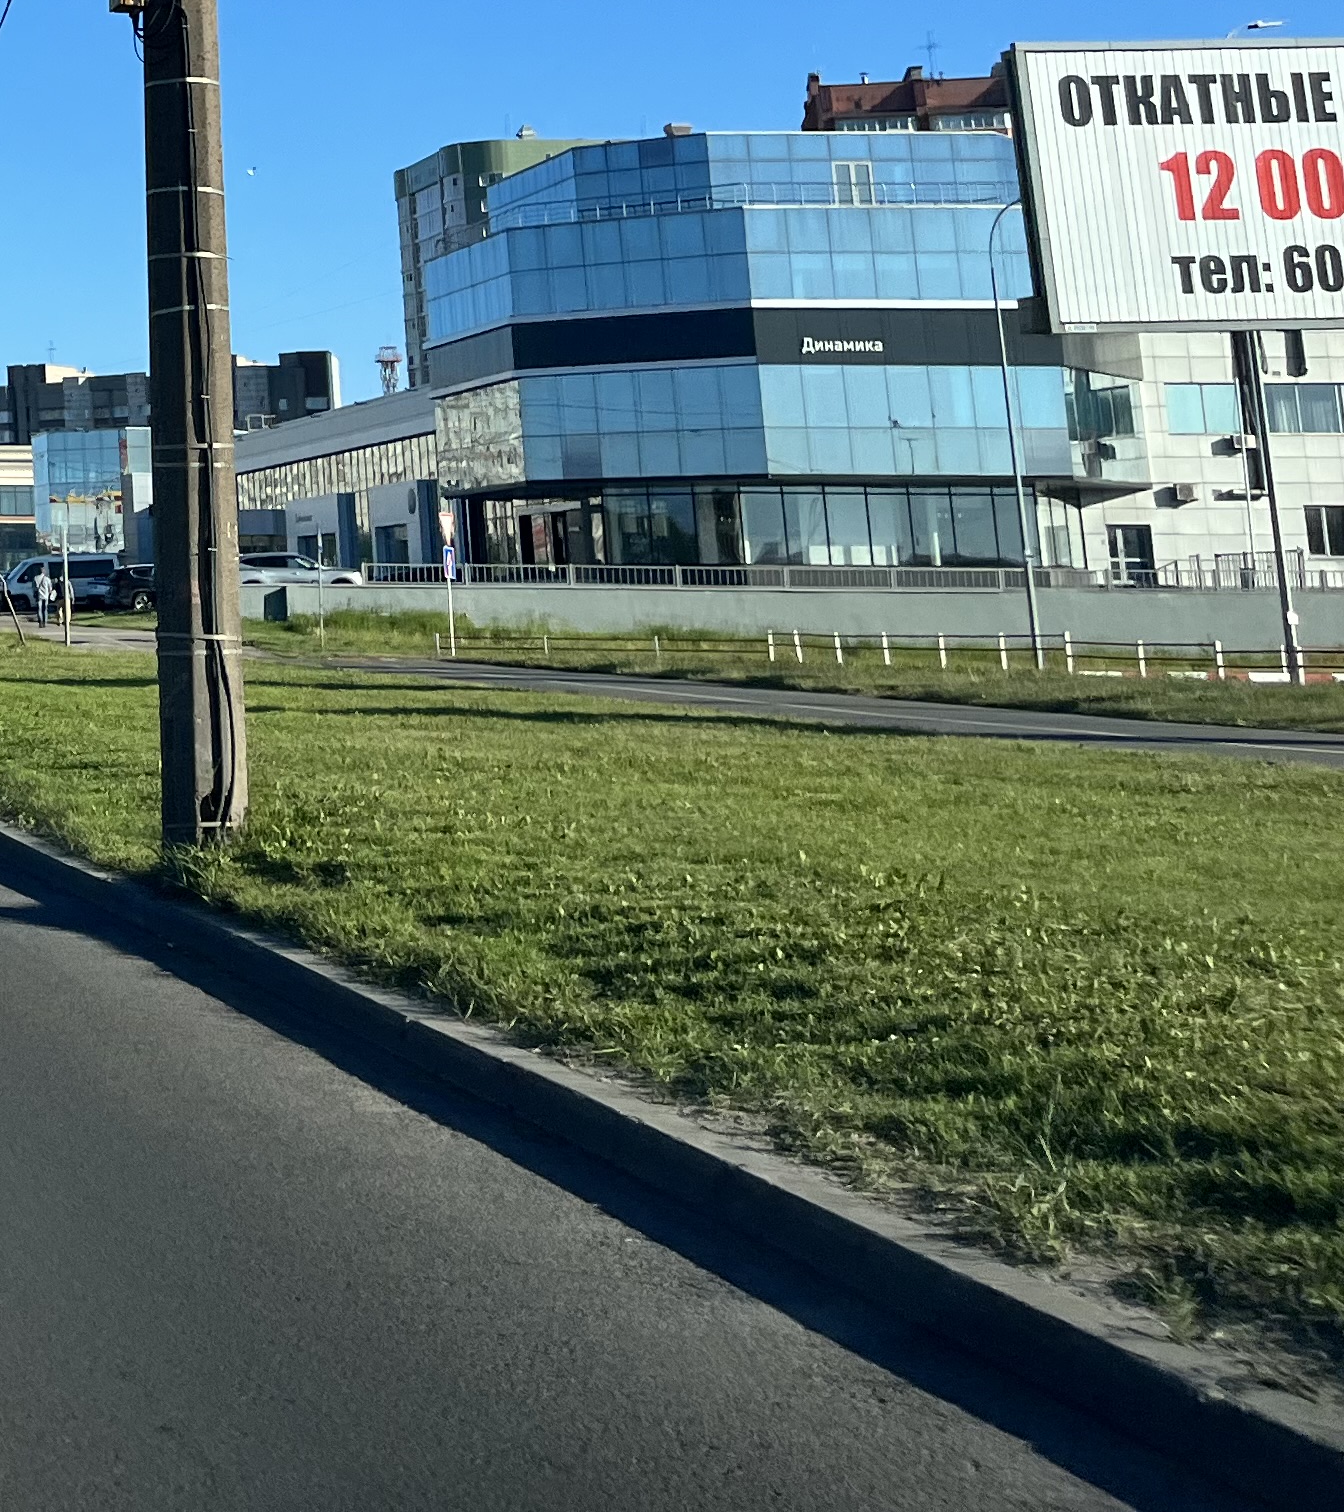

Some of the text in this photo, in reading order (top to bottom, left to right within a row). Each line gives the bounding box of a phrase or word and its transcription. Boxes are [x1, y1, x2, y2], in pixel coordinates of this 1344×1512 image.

[1058, 72, 1337, 127] ОТКАТНЫЕ
[1171, 244, 1344, 294] тел: 60
[801, 337, 884, 354] Динамика
